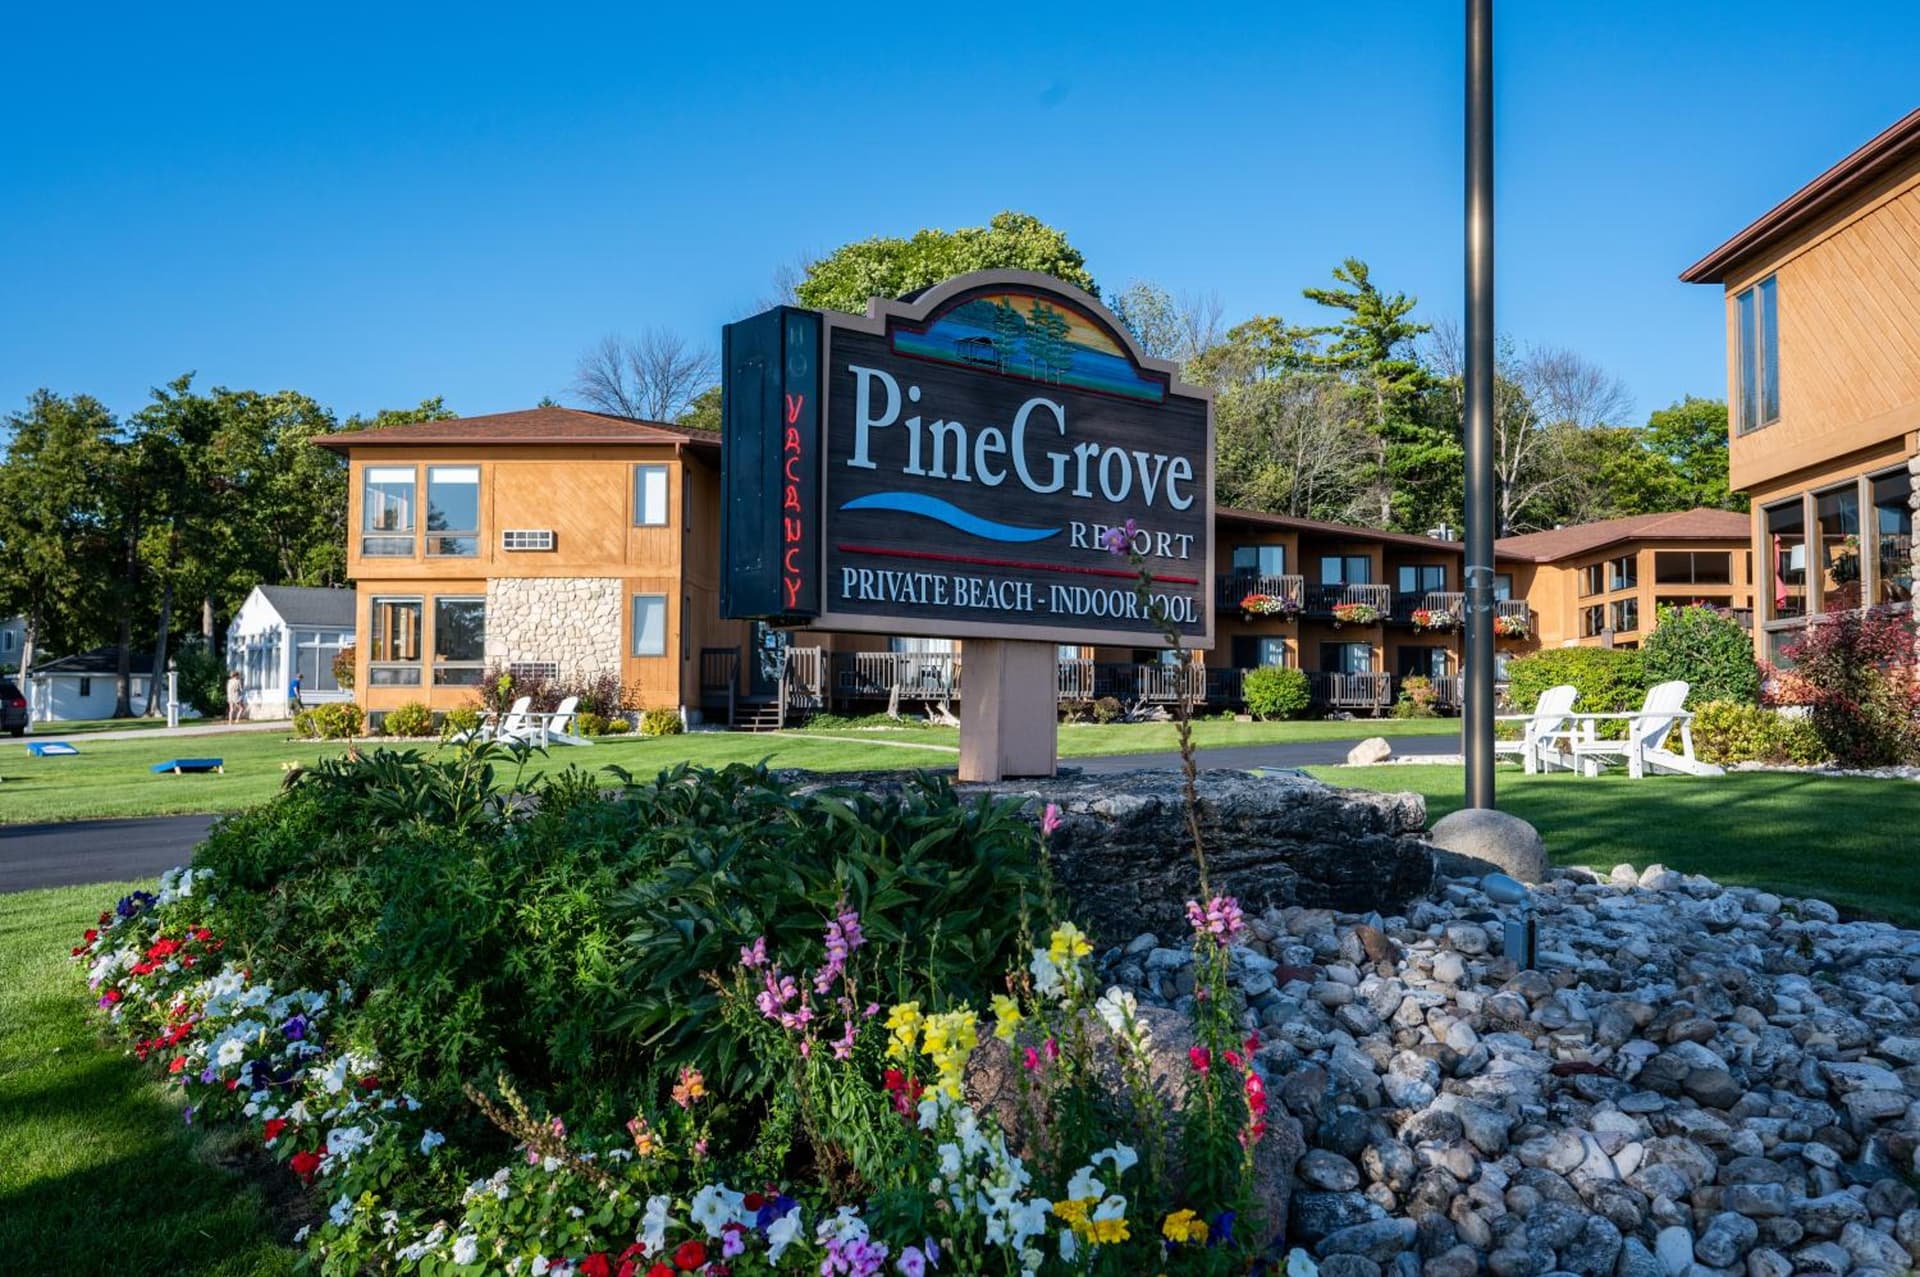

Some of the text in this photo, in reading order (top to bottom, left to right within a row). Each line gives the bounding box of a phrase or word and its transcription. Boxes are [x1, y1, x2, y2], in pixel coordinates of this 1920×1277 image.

[784, 394, 804, 609] VACANCY
[846, 364, 1194, 511] PineGrove
[841, 567, 949, 606] PRIVATE
[953, 576, 1033, 612] BEACH
[1049, 585, 1139, 619] INDOOR
